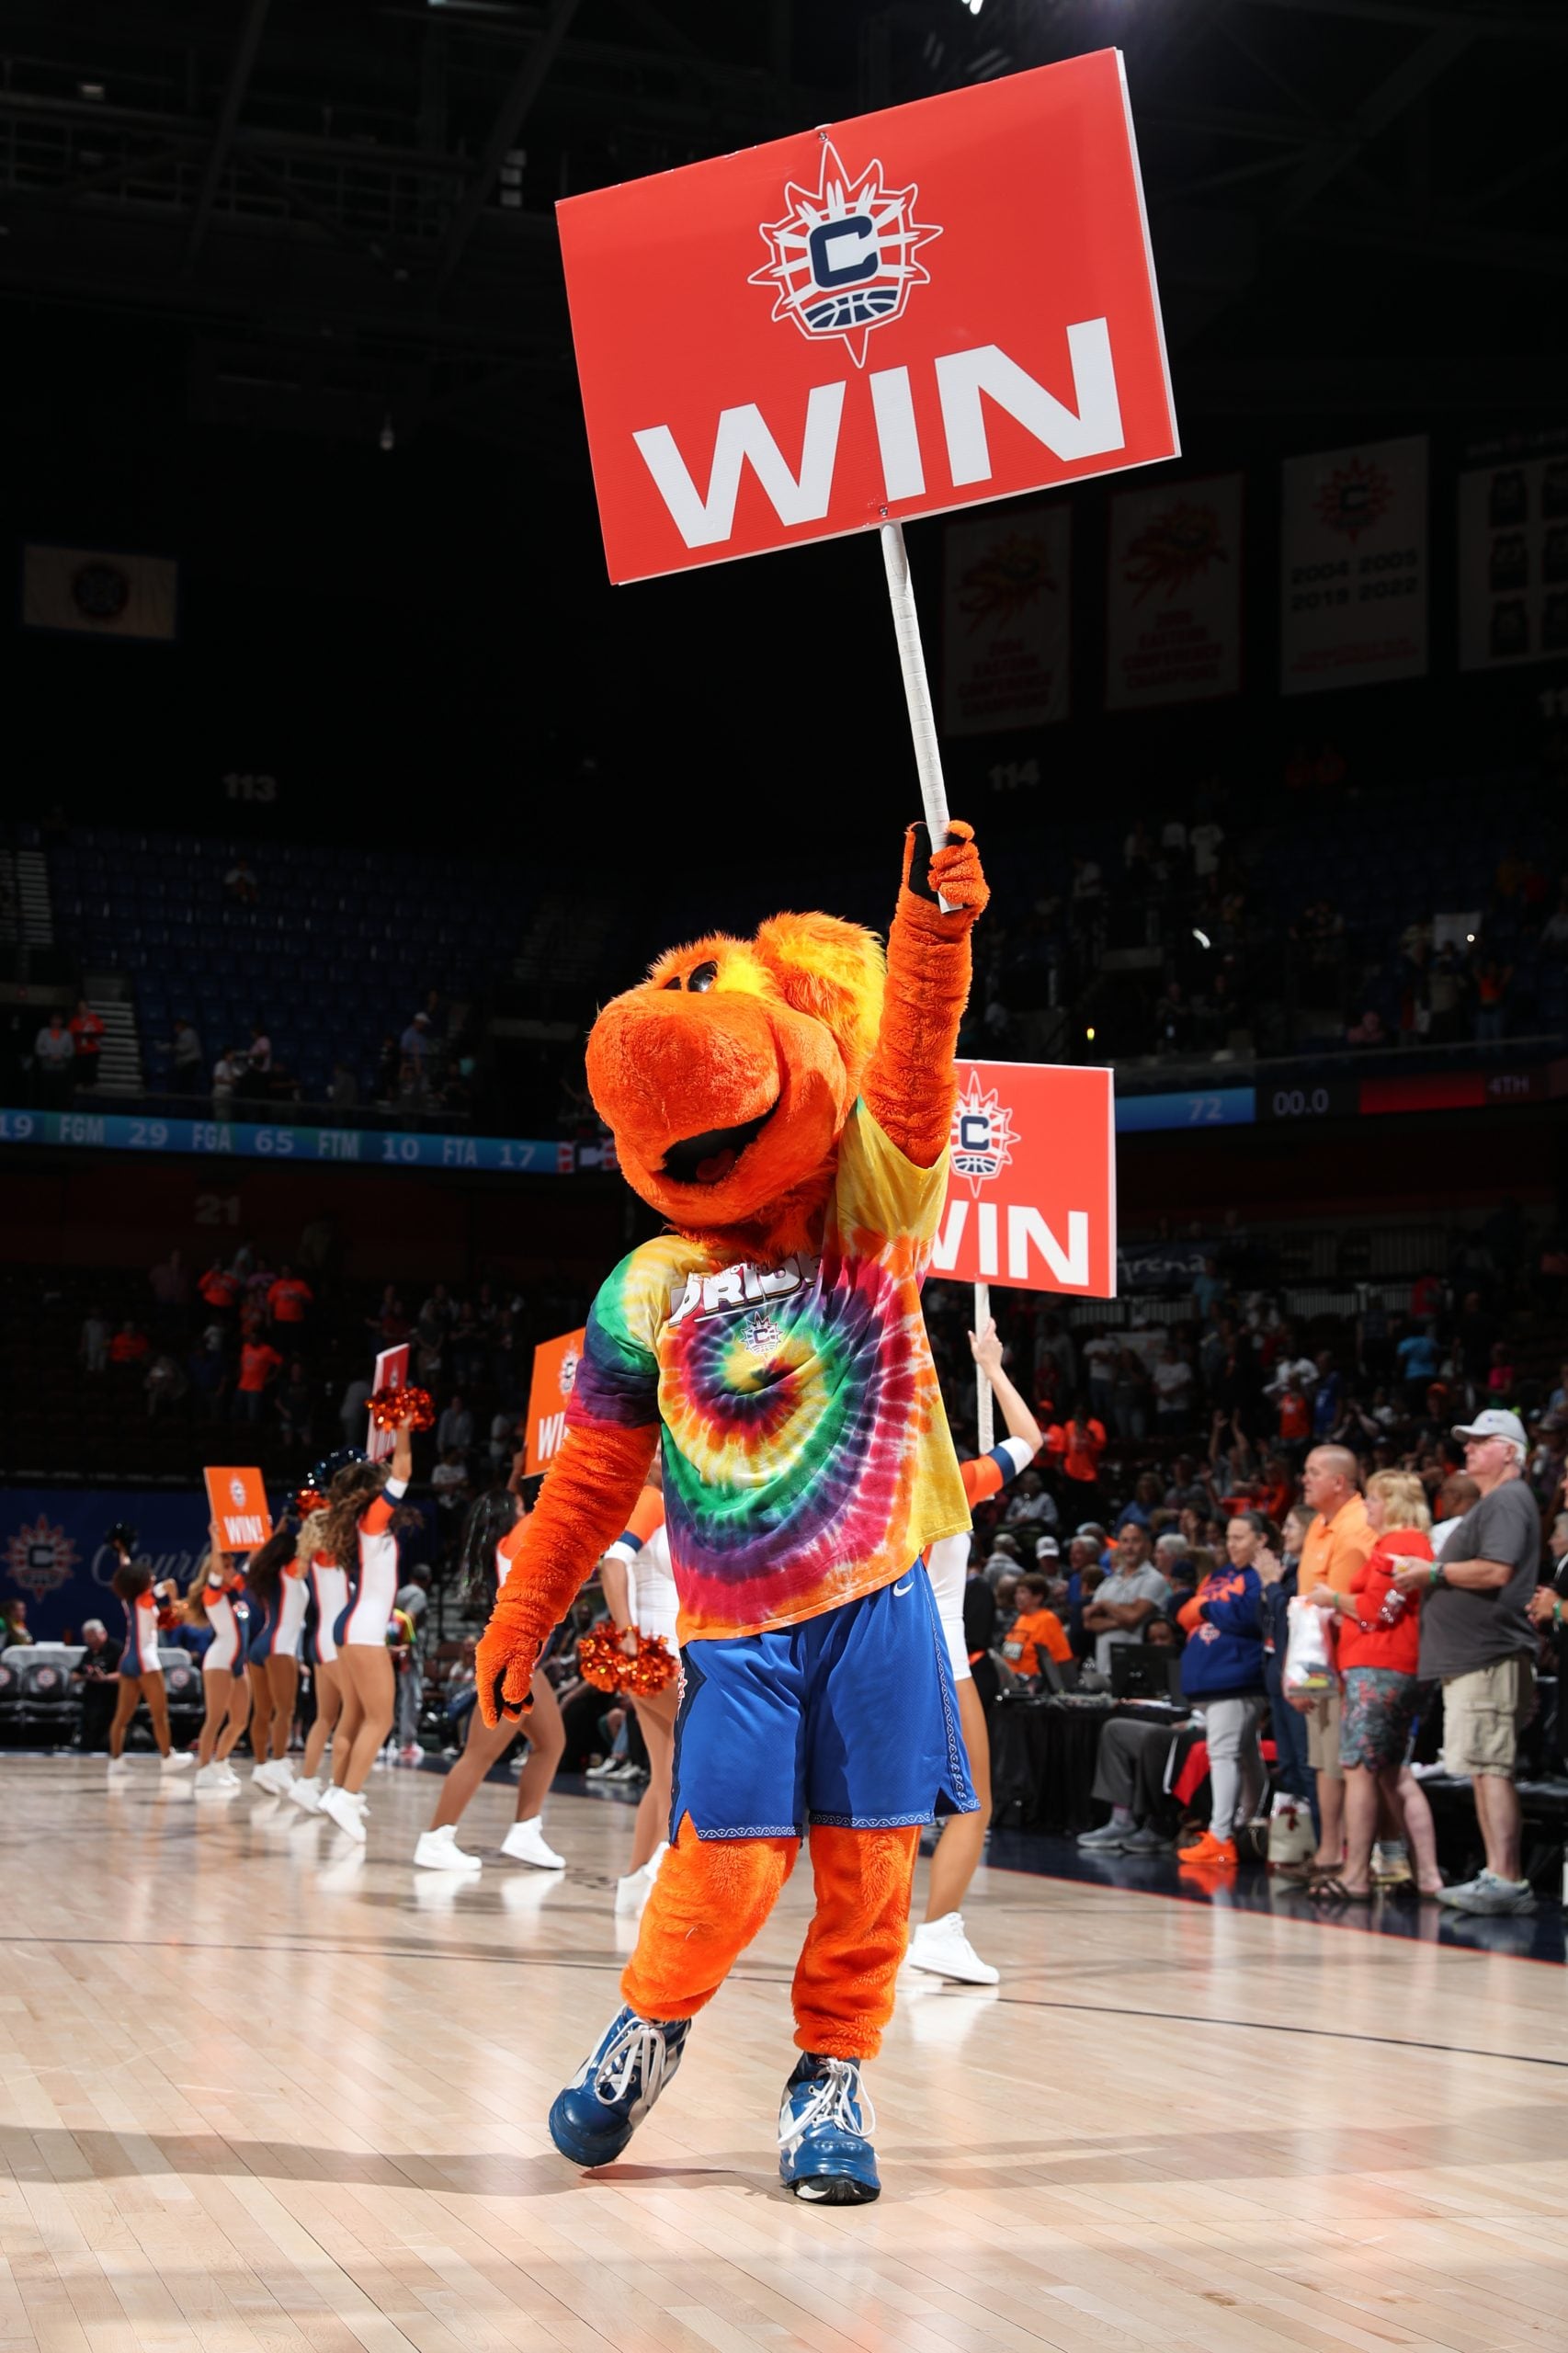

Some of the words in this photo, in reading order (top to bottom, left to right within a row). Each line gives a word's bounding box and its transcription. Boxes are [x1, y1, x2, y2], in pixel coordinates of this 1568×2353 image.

[809, 215, 879, 288] C
[632, 316, 1125, 549] WIN
[222, 772, 278, 803] 113
[987, 758, 1040, 791] 114
[1488, 1074, 1529, 1095] 4TH
[1188, 1097, 1222, 1120] 72
[1272, 1088, 1329, 1117] 00.0
[59, 1114, 105, 1143] FGM
[128, 1121, 169, 1147] 29
[191, 1122, 231, 1151] FGA
[255, 1129, 294, 1154] 65
[317, 1131, 359, 1161] FTM
[382, 1137, 420, 1162] 10
[442, 1139, 478, 1166] FTA
[499, 1144, 536, 1168] 17
[960, 1115, 989, 1151] C
[193, 1193, 242, 1225] 21
[538, 1411, 570, 1461] WI
[223, 1515, 265, 1545] WIN!
